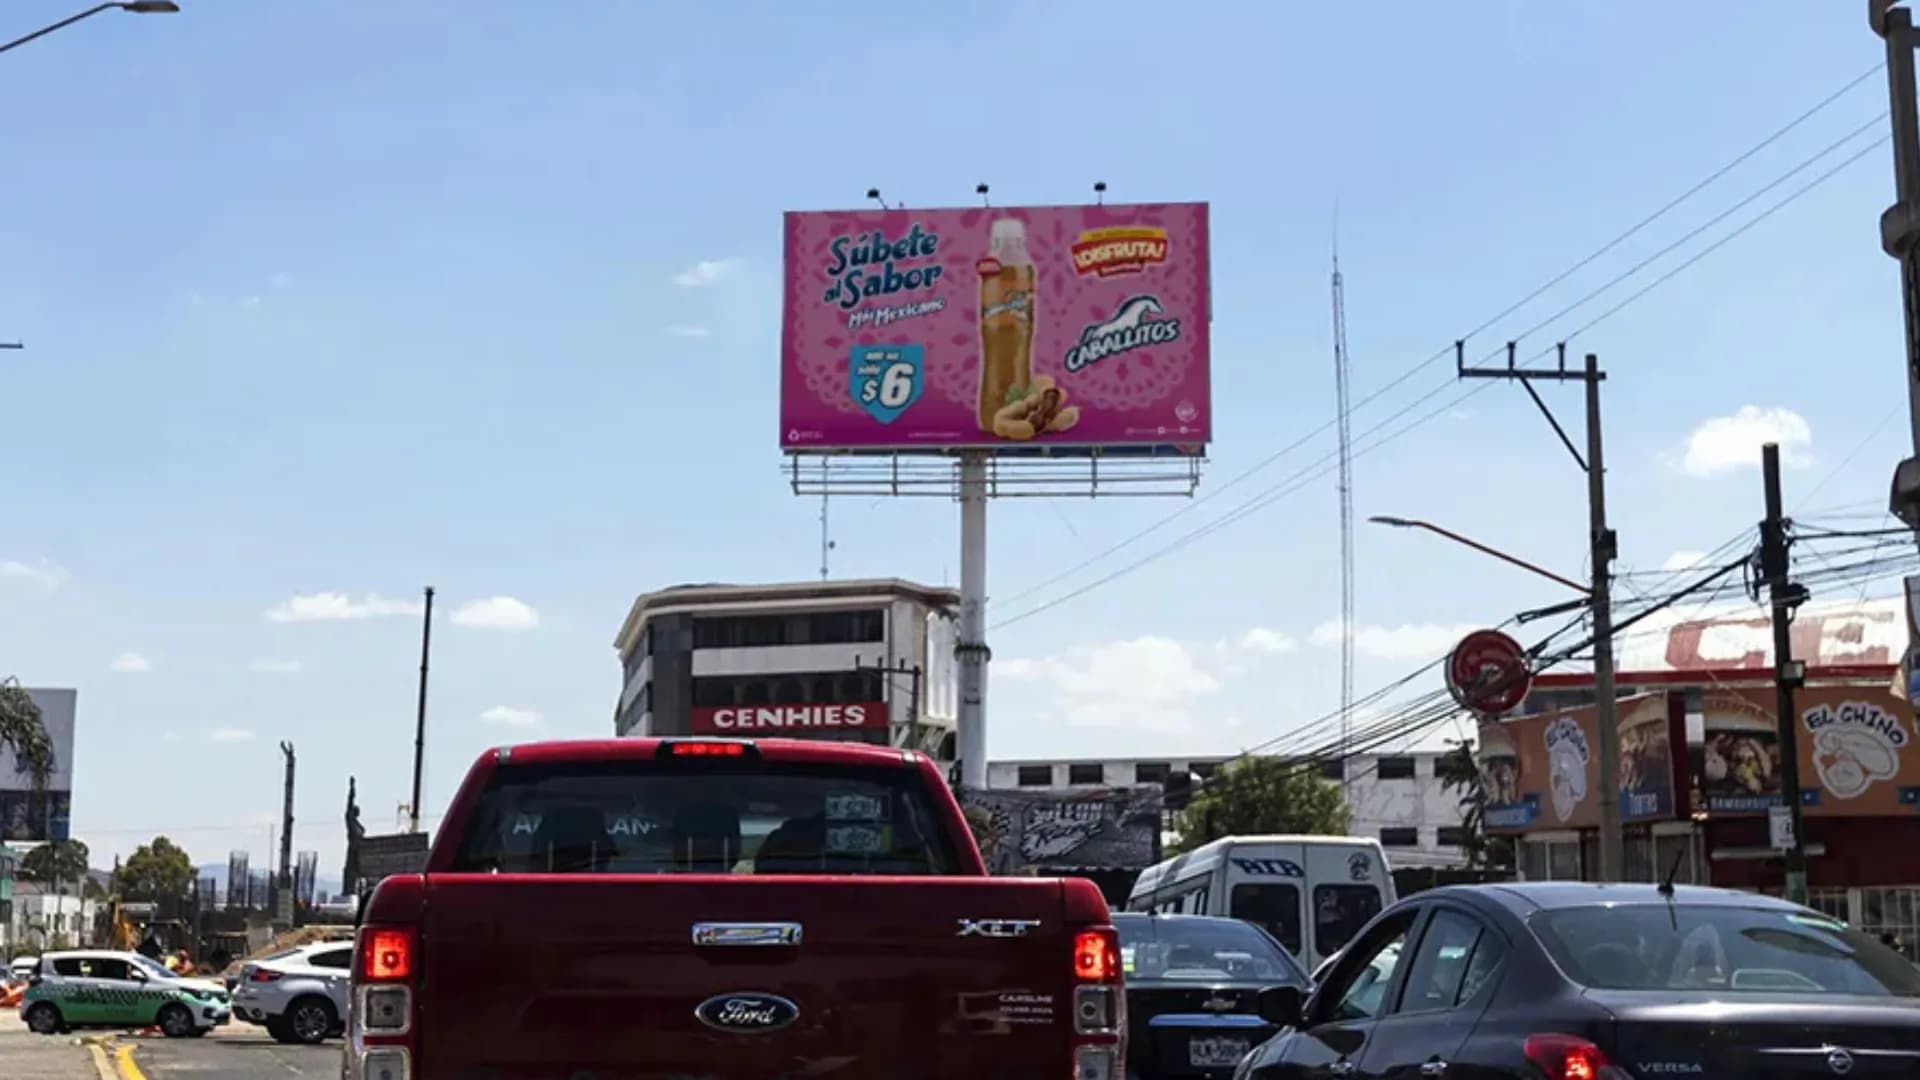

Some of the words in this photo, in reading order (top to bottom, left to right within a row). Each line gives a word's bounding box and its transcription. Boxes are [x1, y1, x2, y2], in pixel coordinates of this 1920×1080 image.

[828, 224, 938, 276] Súbete
[824, 280, 841, 302] al
[840, 261, 943, 308] Sabor
[1066, 319, 1180, 371] CABALLITOS
[862, 362, 914, 408] $6
[713, 705, 866, 729] CENHIES
[1805, 708, 1834, 730] EL
[1840, 705, 1905, 745] CHINO
[956, 919, 1041, 937] XLT
[719, 999, 776, 1024] Ford
[1637, 1061, 1704, 1074] VERSA
